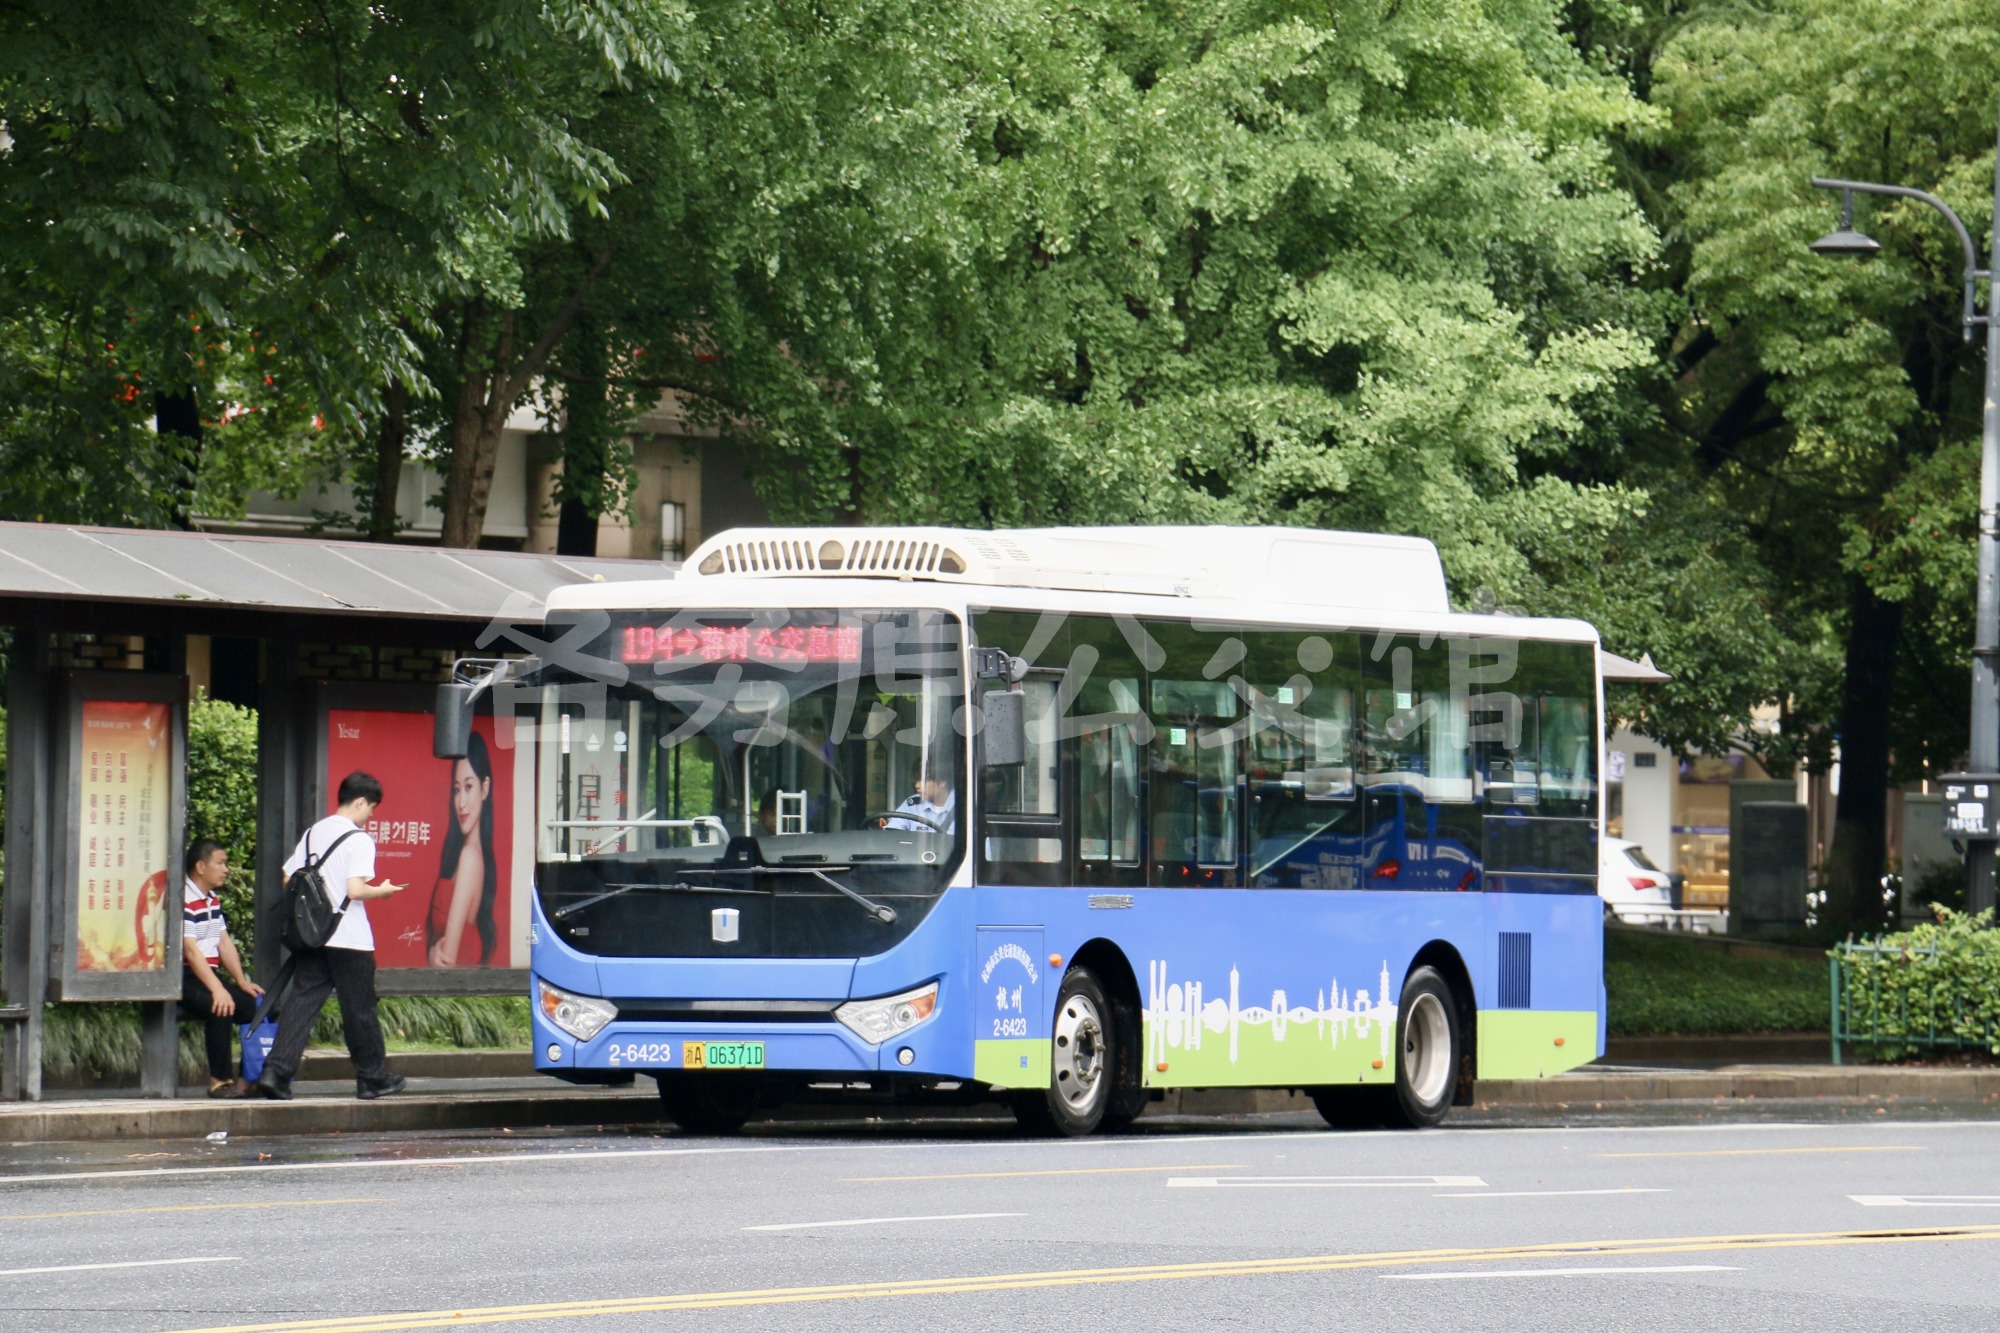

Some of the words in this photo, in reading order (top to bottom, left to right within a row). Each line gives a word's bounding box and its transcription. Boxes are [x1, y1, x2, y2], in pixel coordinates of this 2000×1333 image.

[623, 626, 673, 660] 194
[701, 626, 859, 659] 蒋村公交总站
[359, 820, 431, 845] 品牌21周年
[996, 984, 1022, 1014] 杭州
[993, 1018, 1027, 1037] 2-6423
[609, 1044, 671, 1062] 2-6423
